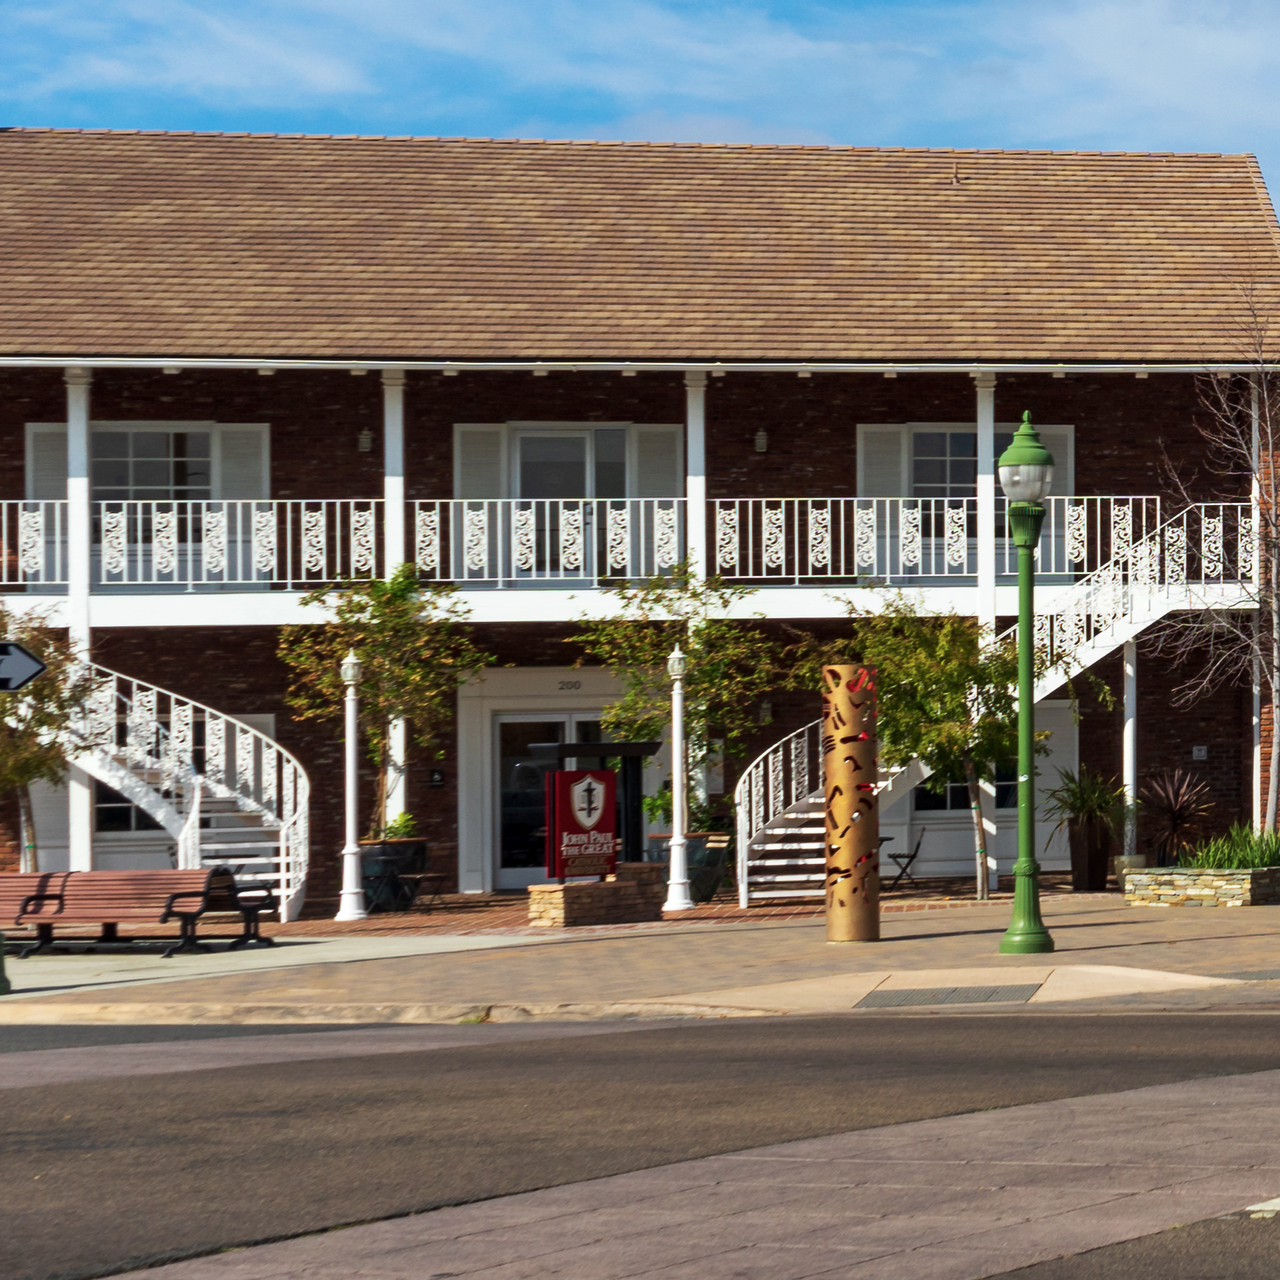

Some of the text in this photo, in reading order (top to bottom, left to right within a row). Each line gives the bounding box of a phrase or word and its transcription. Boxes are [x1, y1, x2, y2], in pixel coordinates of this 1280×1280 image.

[558, 681, 581, 690] 200
[562, 830, 614, 846] JOHN PAUL
[562, 843, 614, 855] THE GREAT
